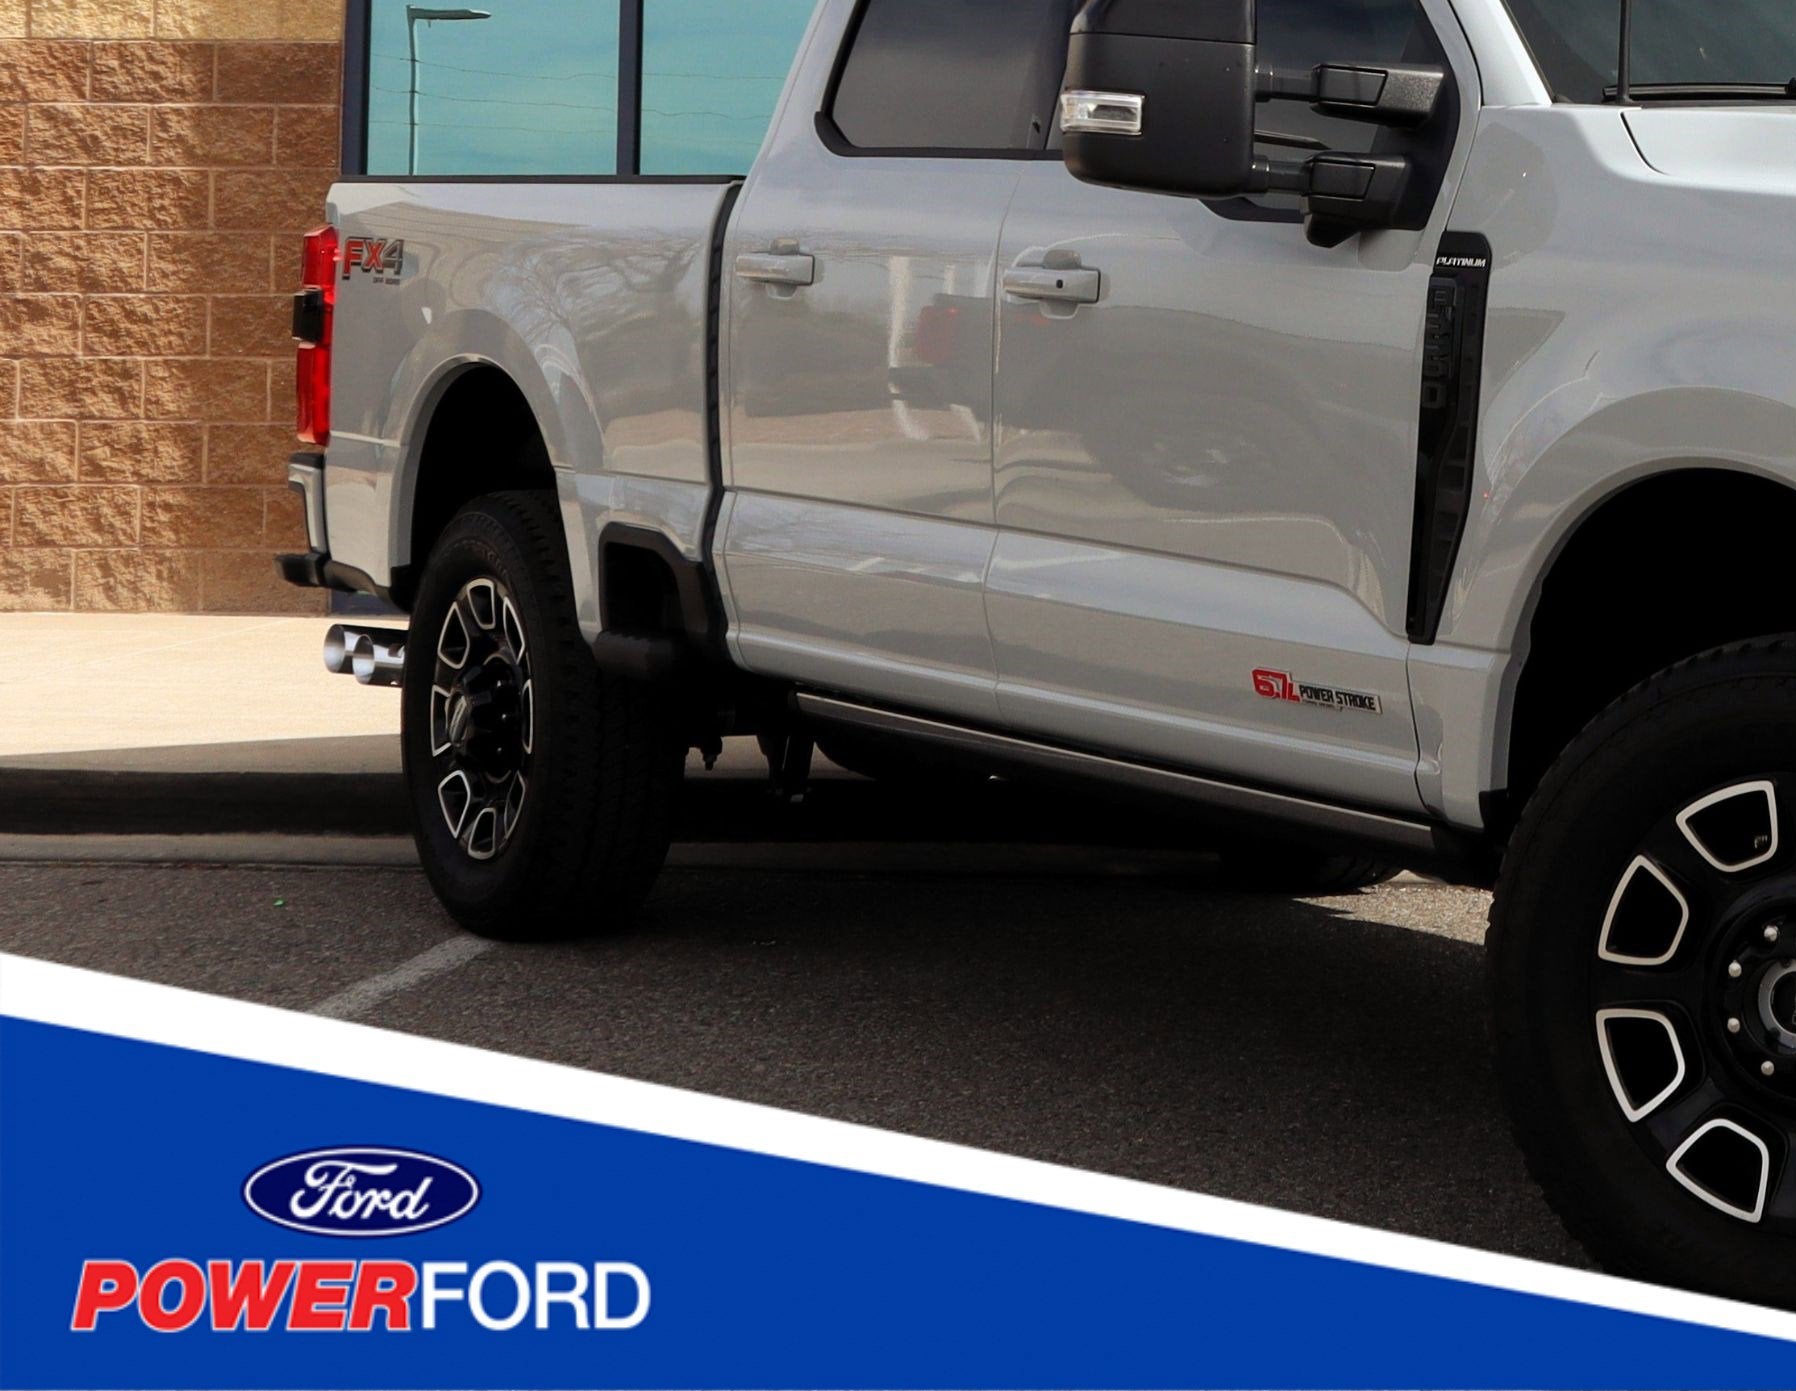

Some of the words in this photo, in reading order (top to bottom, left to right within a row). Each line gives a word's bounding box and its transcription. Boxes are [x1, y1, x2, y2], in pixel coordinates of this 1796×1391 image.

[342, 236, 405, 280] FX4
[1436, 256, 1487, 268] PLATINUM
[1299, 684, 1335, 705] POWER
[1335, 690, 1377, 712] STROKE
